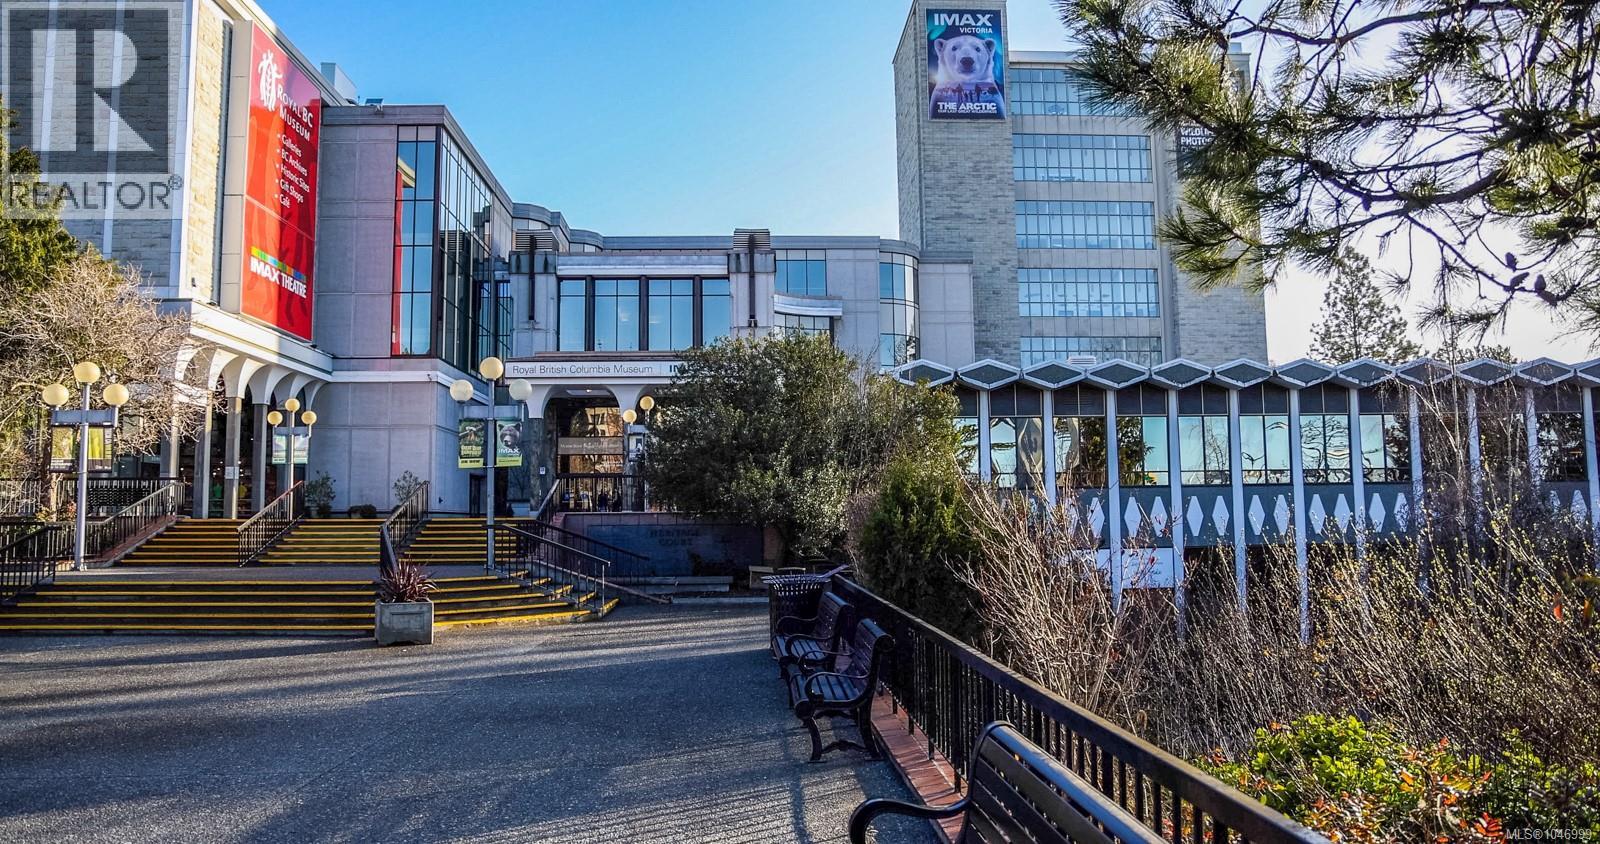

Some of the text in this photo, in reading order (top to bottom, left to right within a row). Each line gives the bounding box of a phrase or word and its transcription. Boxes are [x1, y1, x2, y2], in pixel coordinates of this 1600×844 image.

[934, 13, 992, 26] IMAX
[277, 84, 313, 128] ROYAL BC
[937, 101, 997, 110] THE ARCTIC
[279, 104, 310, 141] MUSEUM
[282, 134, 302, 157] Galleries
[281, 148, 307, 176] BC Archives
[280, 164, 310, 193] Historic Sites
[280, 178, 304, 204] Gift Shops
[250, 256, 307, 298] IMAX THEATRE
[512, 365, 653, 376] Royal British Columbia Museum
